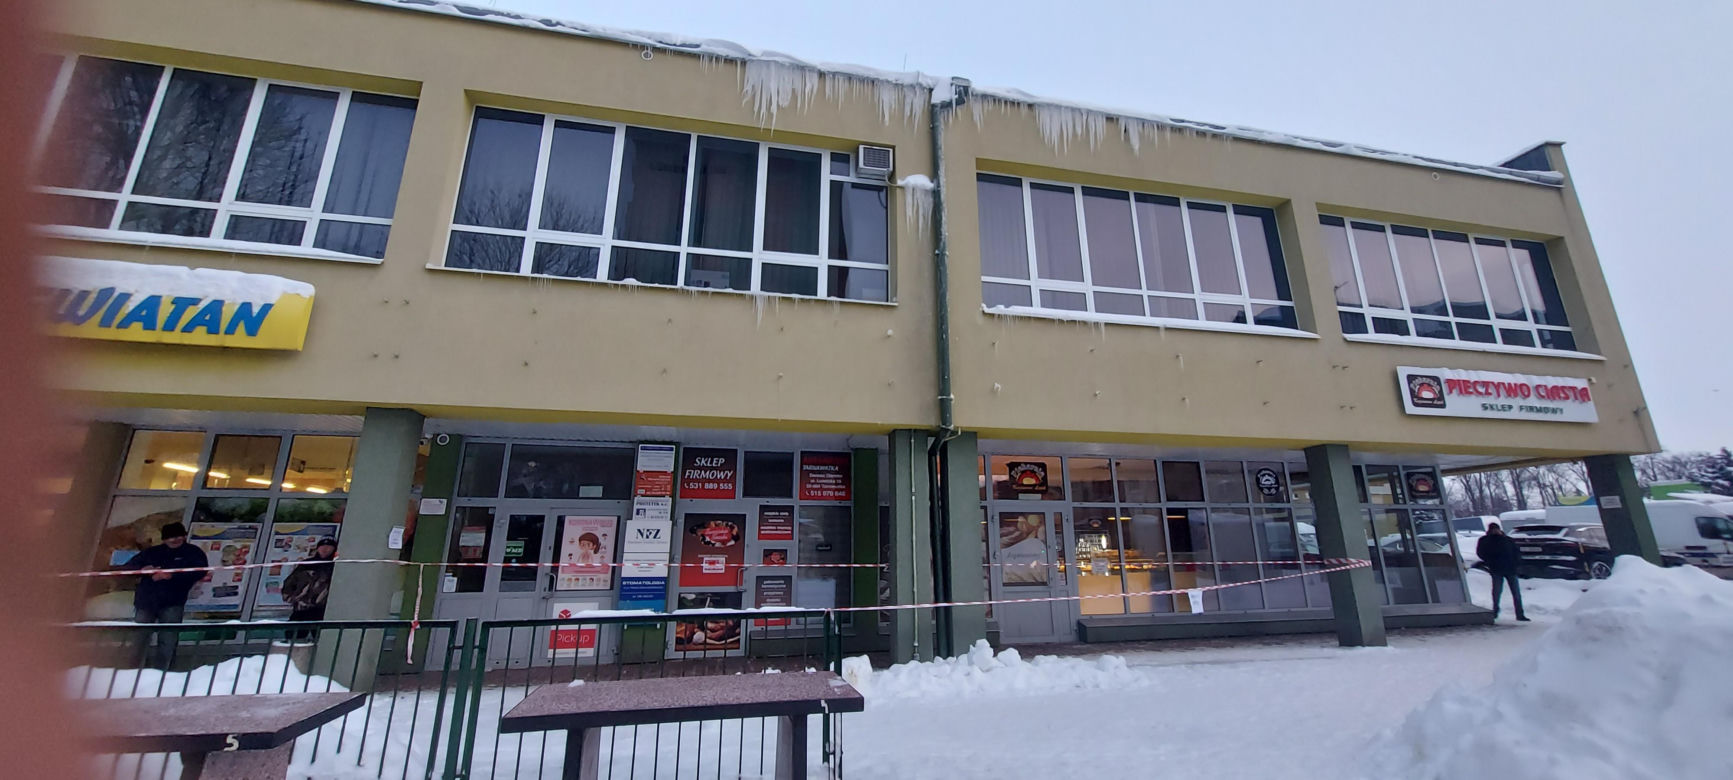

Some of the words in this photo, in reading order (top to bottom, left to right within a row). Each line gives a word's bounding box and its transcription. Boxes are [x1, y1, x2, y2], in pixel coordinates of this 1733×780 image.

[1444, 379, 1532, 399] PIECZYWO
[1536, 384, 1592, 403] CIASTA
[1481, 403, 1514, 412] SKLEP
[1519, 404, 1564, 415] FIRMOWY
[694, 457, 725, 467] SKLEP
[684, 469, 734, 480] FIRMOWY
[635, 528, 662, 540] NFZ
[223, 734, 239, 751] 5
